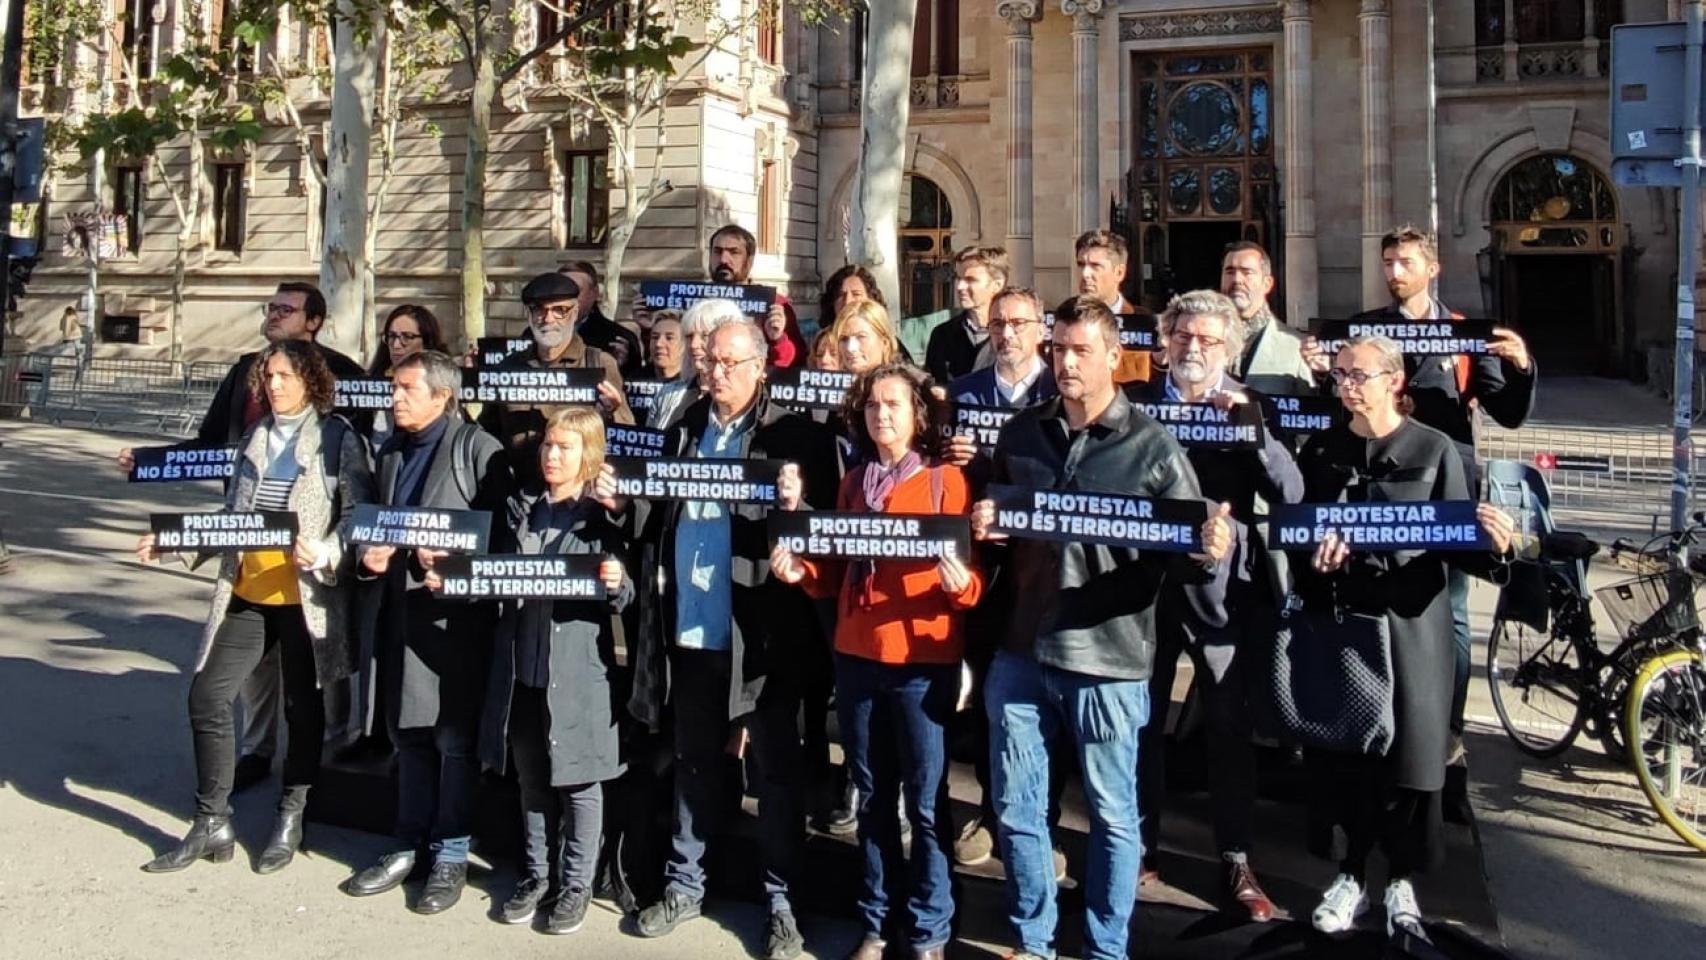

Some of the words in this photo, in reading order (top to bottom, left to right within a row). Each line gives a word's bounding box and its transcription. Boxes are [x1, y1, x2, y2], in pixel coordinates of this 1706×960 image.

[669, 283, 744, 298] PROTESTAR
[646, 295, 665, 307] NO
[667, 294, 682, 308] ÉS
[1349, 324, 1453, 337] PROTESTAR
[335, 380, 393, 393] PROTEST
[479, 372, 568, 386] PROTESTAR
[800, 370, 857, 388] PROTE
[351, 394, 393, 408] TERRO
[478, 385, 496, 401] ÉS
[498, 387, 596, 402] TERRORISME
[771, 384, 794, 400] NO
[797, 384, 816, 402] ÉS
[1281, 414, 1332, 430] RISME
[607, 427, 665, 448] PROTES
[166, 448, 238, 463] PROTEST
[137, 466, 161, 479] NO
[163, 462, 181, 478] ÉS
[184, 463, 235, 478] TERRO
[646, 462, 744, 482] PROTESTAR
[617, 479, 642, 497] NO
[645, 477, 663, 497] ÉS
[667, 480, 776, 500] TERRORISME
[1034, 491, 1153, 519] PROTESTAR
[183, 515, 264, 529] PROTESTAR
[377, 510, 451, 529] PROTESTAR
[1315, 505, 1436, 524] PROTESTAR
[809, 517, 920, 537] PROTESTAR
[999, 510, 1028, 529] NO
[1031, 509, 1055, 533] ÉS
[1059, 514, 1193, 545] TERRORISME
[1280, 526, 1309, 544] NO
[1342, 525, 1478, 543] TERRORISME
[159, 532, 180, 547] NO
[183, 529, 200, 547] ÉS
[201, 530, 291, 546] TERRORISME
[351, 526, 371, 541] NO
[371, 523, 386, 542] ÉS
[386, 528, 478, 550] TERRORISME
[778, 536, 805, 553] NO
[808, 533, 831, 554] ÉS
[834, 537, 957, 558] TERRORISME
[471, 560, 566, 576] PROTESTAR
[444, 579, 467, 595] NO
[470, 577, 489, 595] ÉS
[492, 579, 596, 596] TERRORISME
